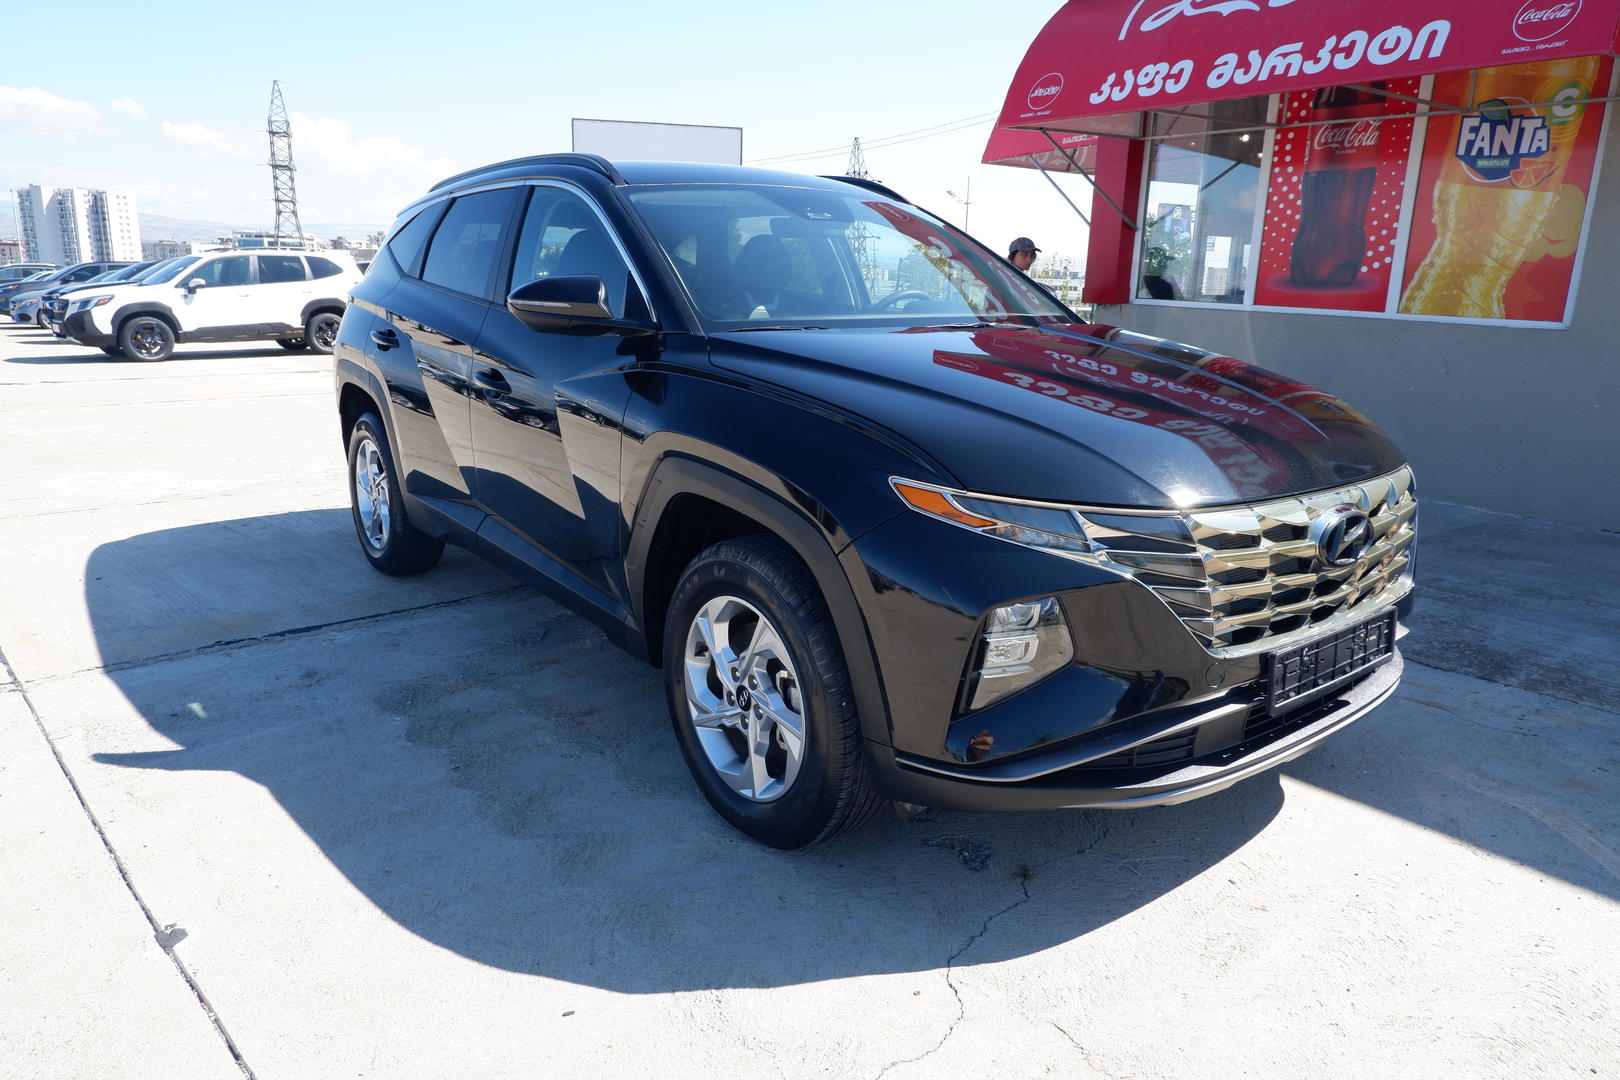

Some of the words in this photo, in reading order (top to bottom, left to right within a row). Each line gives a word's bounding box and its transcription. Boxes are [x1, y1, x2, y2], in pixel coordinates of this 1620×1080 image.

[1089, 59, 1194, 105] კაფე
[1207, 19, 1451, 89] მარკეტი
[1314, 119, 1382, 150] Coca-Cola
[1456, 117, 1548, 156] FANTA
